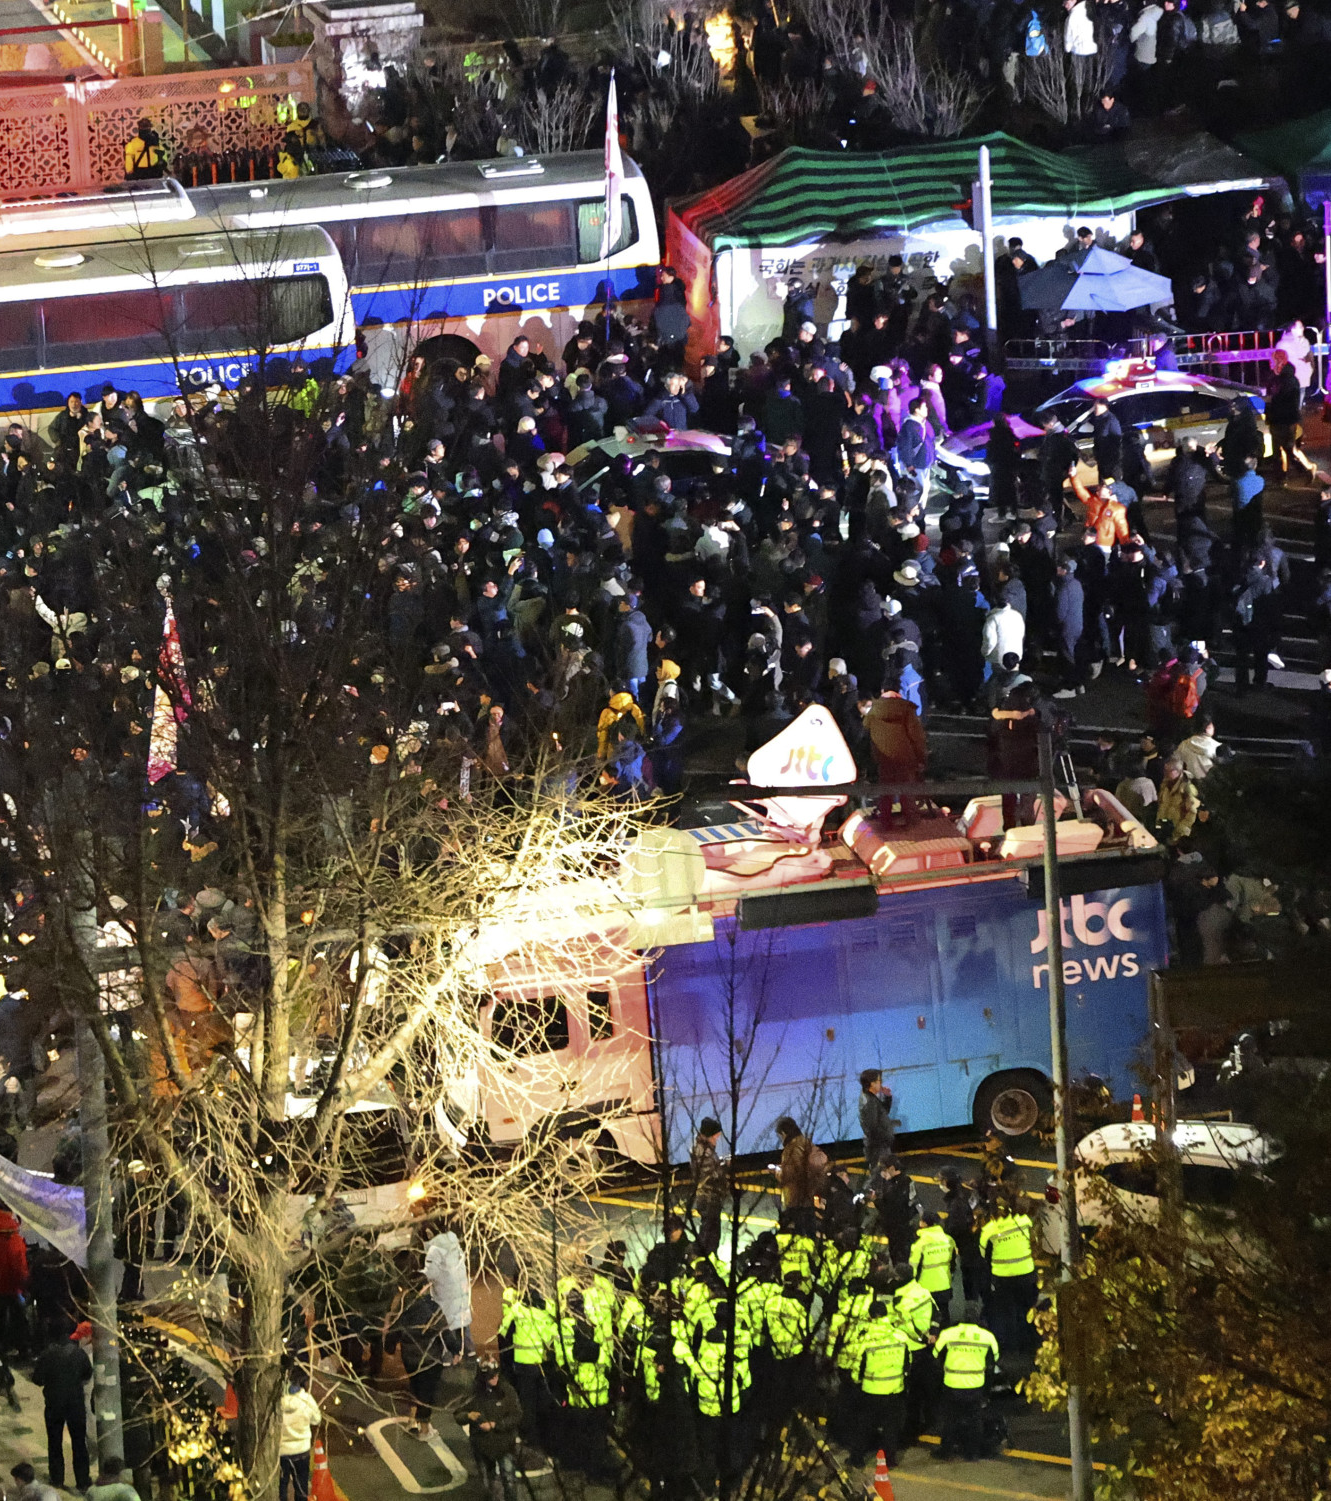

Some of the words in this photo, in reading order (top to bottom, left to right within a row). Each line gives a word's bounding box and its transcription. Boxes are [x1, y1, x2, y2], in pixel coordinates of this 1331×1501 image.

[759, 259, 805, 275] 국회는
[483, 282, 561, 307] POLICE
[1032, 952, 1140, 989] news
